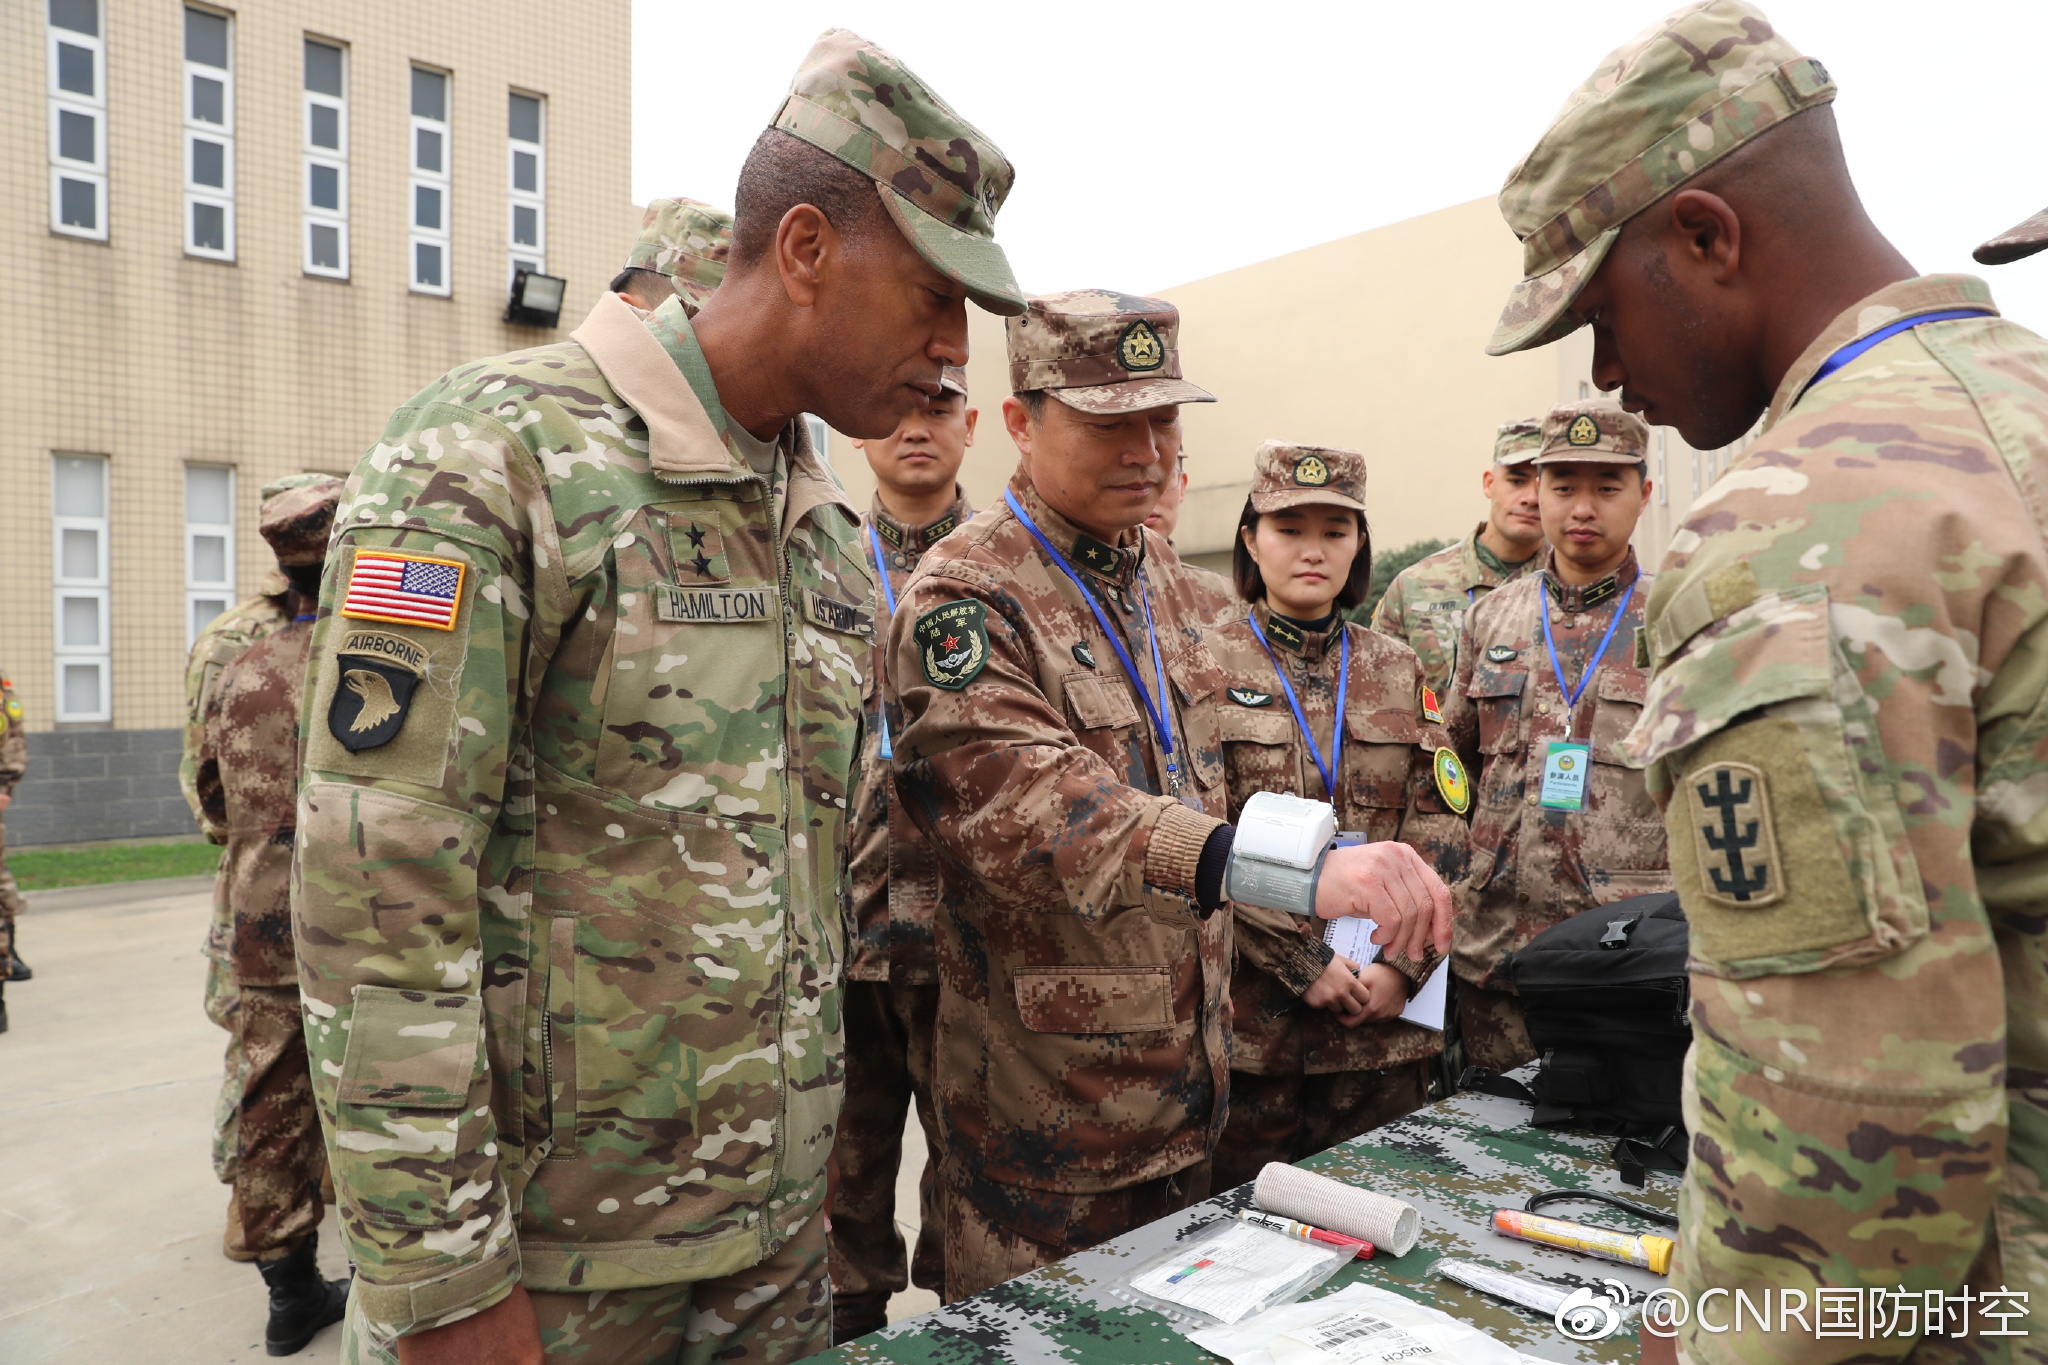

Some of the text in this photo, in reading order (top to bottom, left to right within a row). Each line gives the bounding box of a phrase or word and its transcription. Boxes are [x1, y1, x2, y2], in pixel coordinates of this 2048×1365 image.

[669, 591, 766, 618] HAMILTON
[828, 601, 857, 631] ARMY
[918, 605, 977, 634] 中国人民解放军
[347, 636, 424, 667] AIRBORNE
